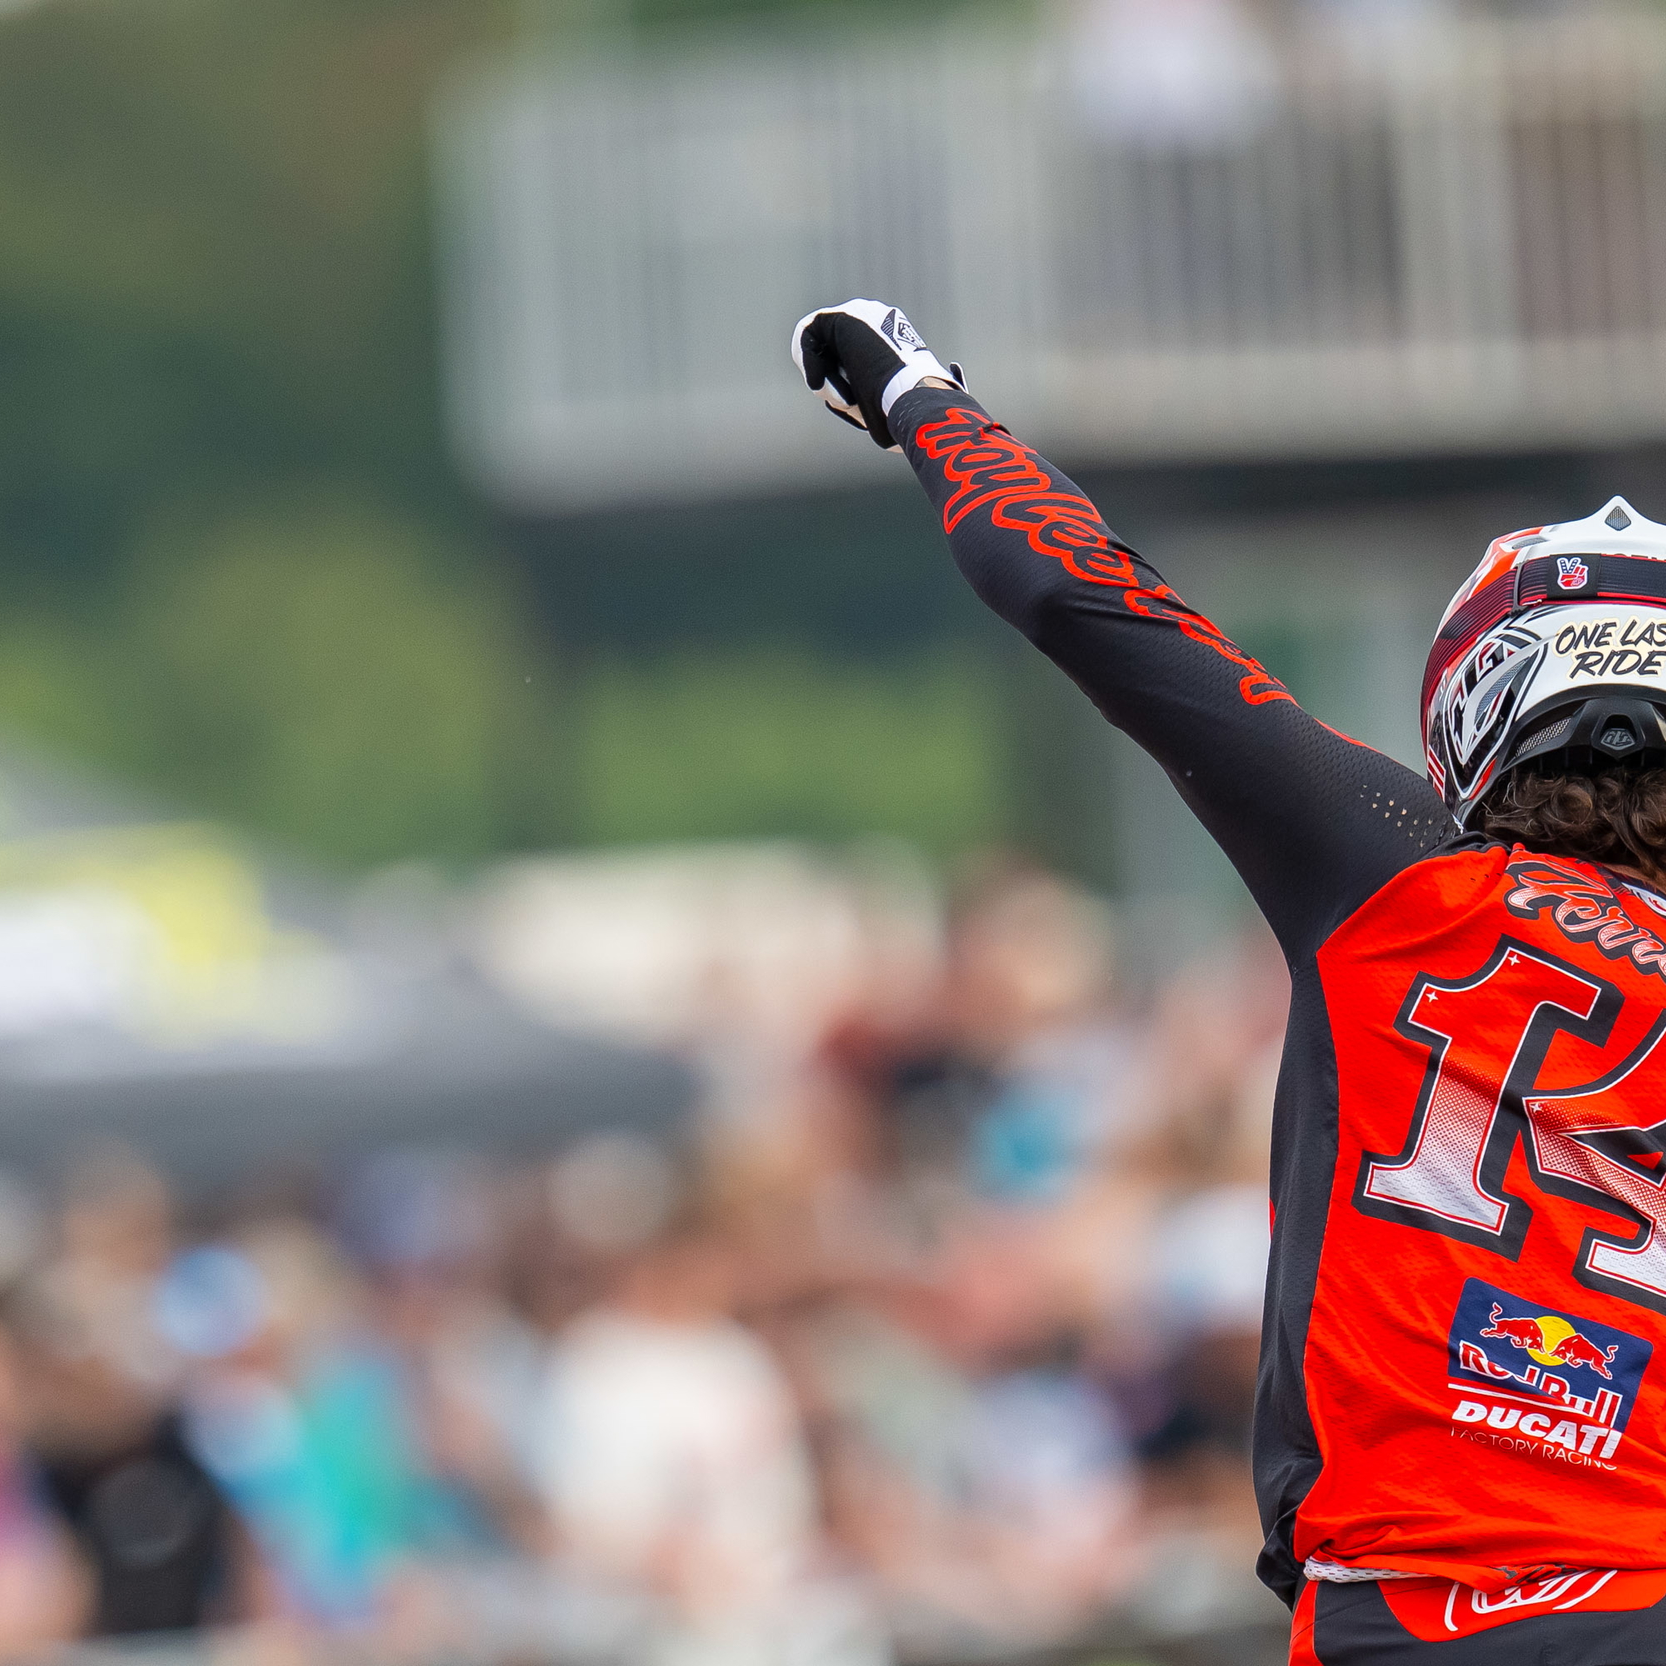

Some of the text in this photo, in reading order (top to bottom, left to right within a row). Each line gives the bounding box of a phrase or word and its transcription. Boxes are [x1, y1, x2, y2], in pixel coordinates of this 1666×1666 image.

[1555, 621, 1618, 655] ONE
[1450, 1427, 1539, 1455] FACTORY
[1451, 1400, 1623, 1460] DUCATI
